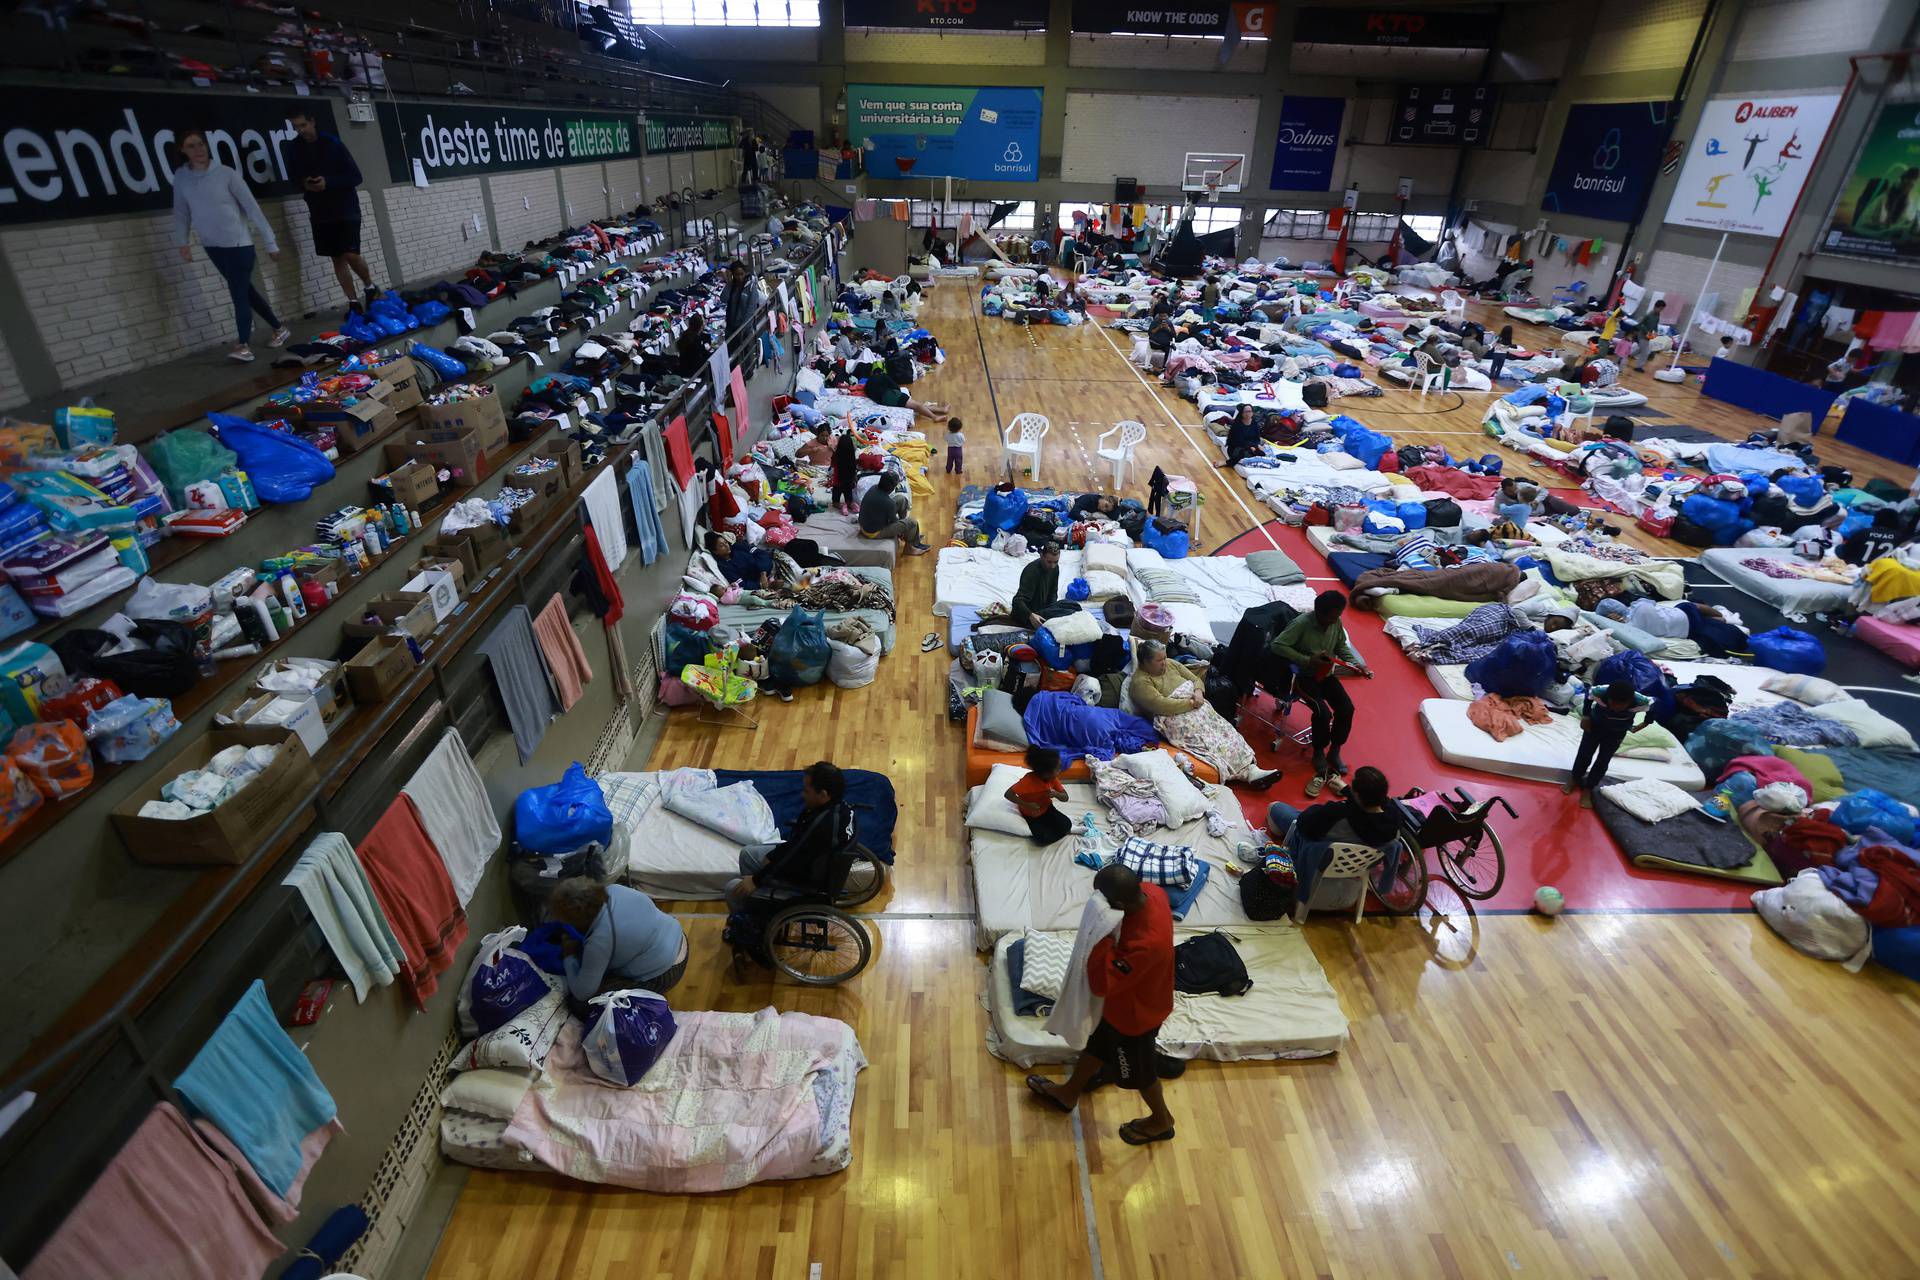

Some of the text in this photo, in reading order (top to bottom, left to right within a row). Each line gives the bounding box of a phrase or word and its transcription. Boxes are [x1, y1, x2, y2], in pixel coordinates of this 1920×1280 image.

[930, 17, 965, 25] KTO.COM
[1126, 9, 1219, 26] KNOW THE ODDS
[1245, 8, 1264, 31] G
[859, 99, 963, 113] Vem que sua conta
[1752, 105, 1798, 119] ALIBEM
[860, 113, 963, 124] universitária tá on.
[420, 113, 630, 168] deste time de atletas de
[646, 119, 666, 149] fibra
[1279, 128, 1335, 146] Dohms
[994, 163, 1032, 173] banrisul
[1573, 172, 1626, 193] banrisul
[1861, 540, 1894, 562] 12
